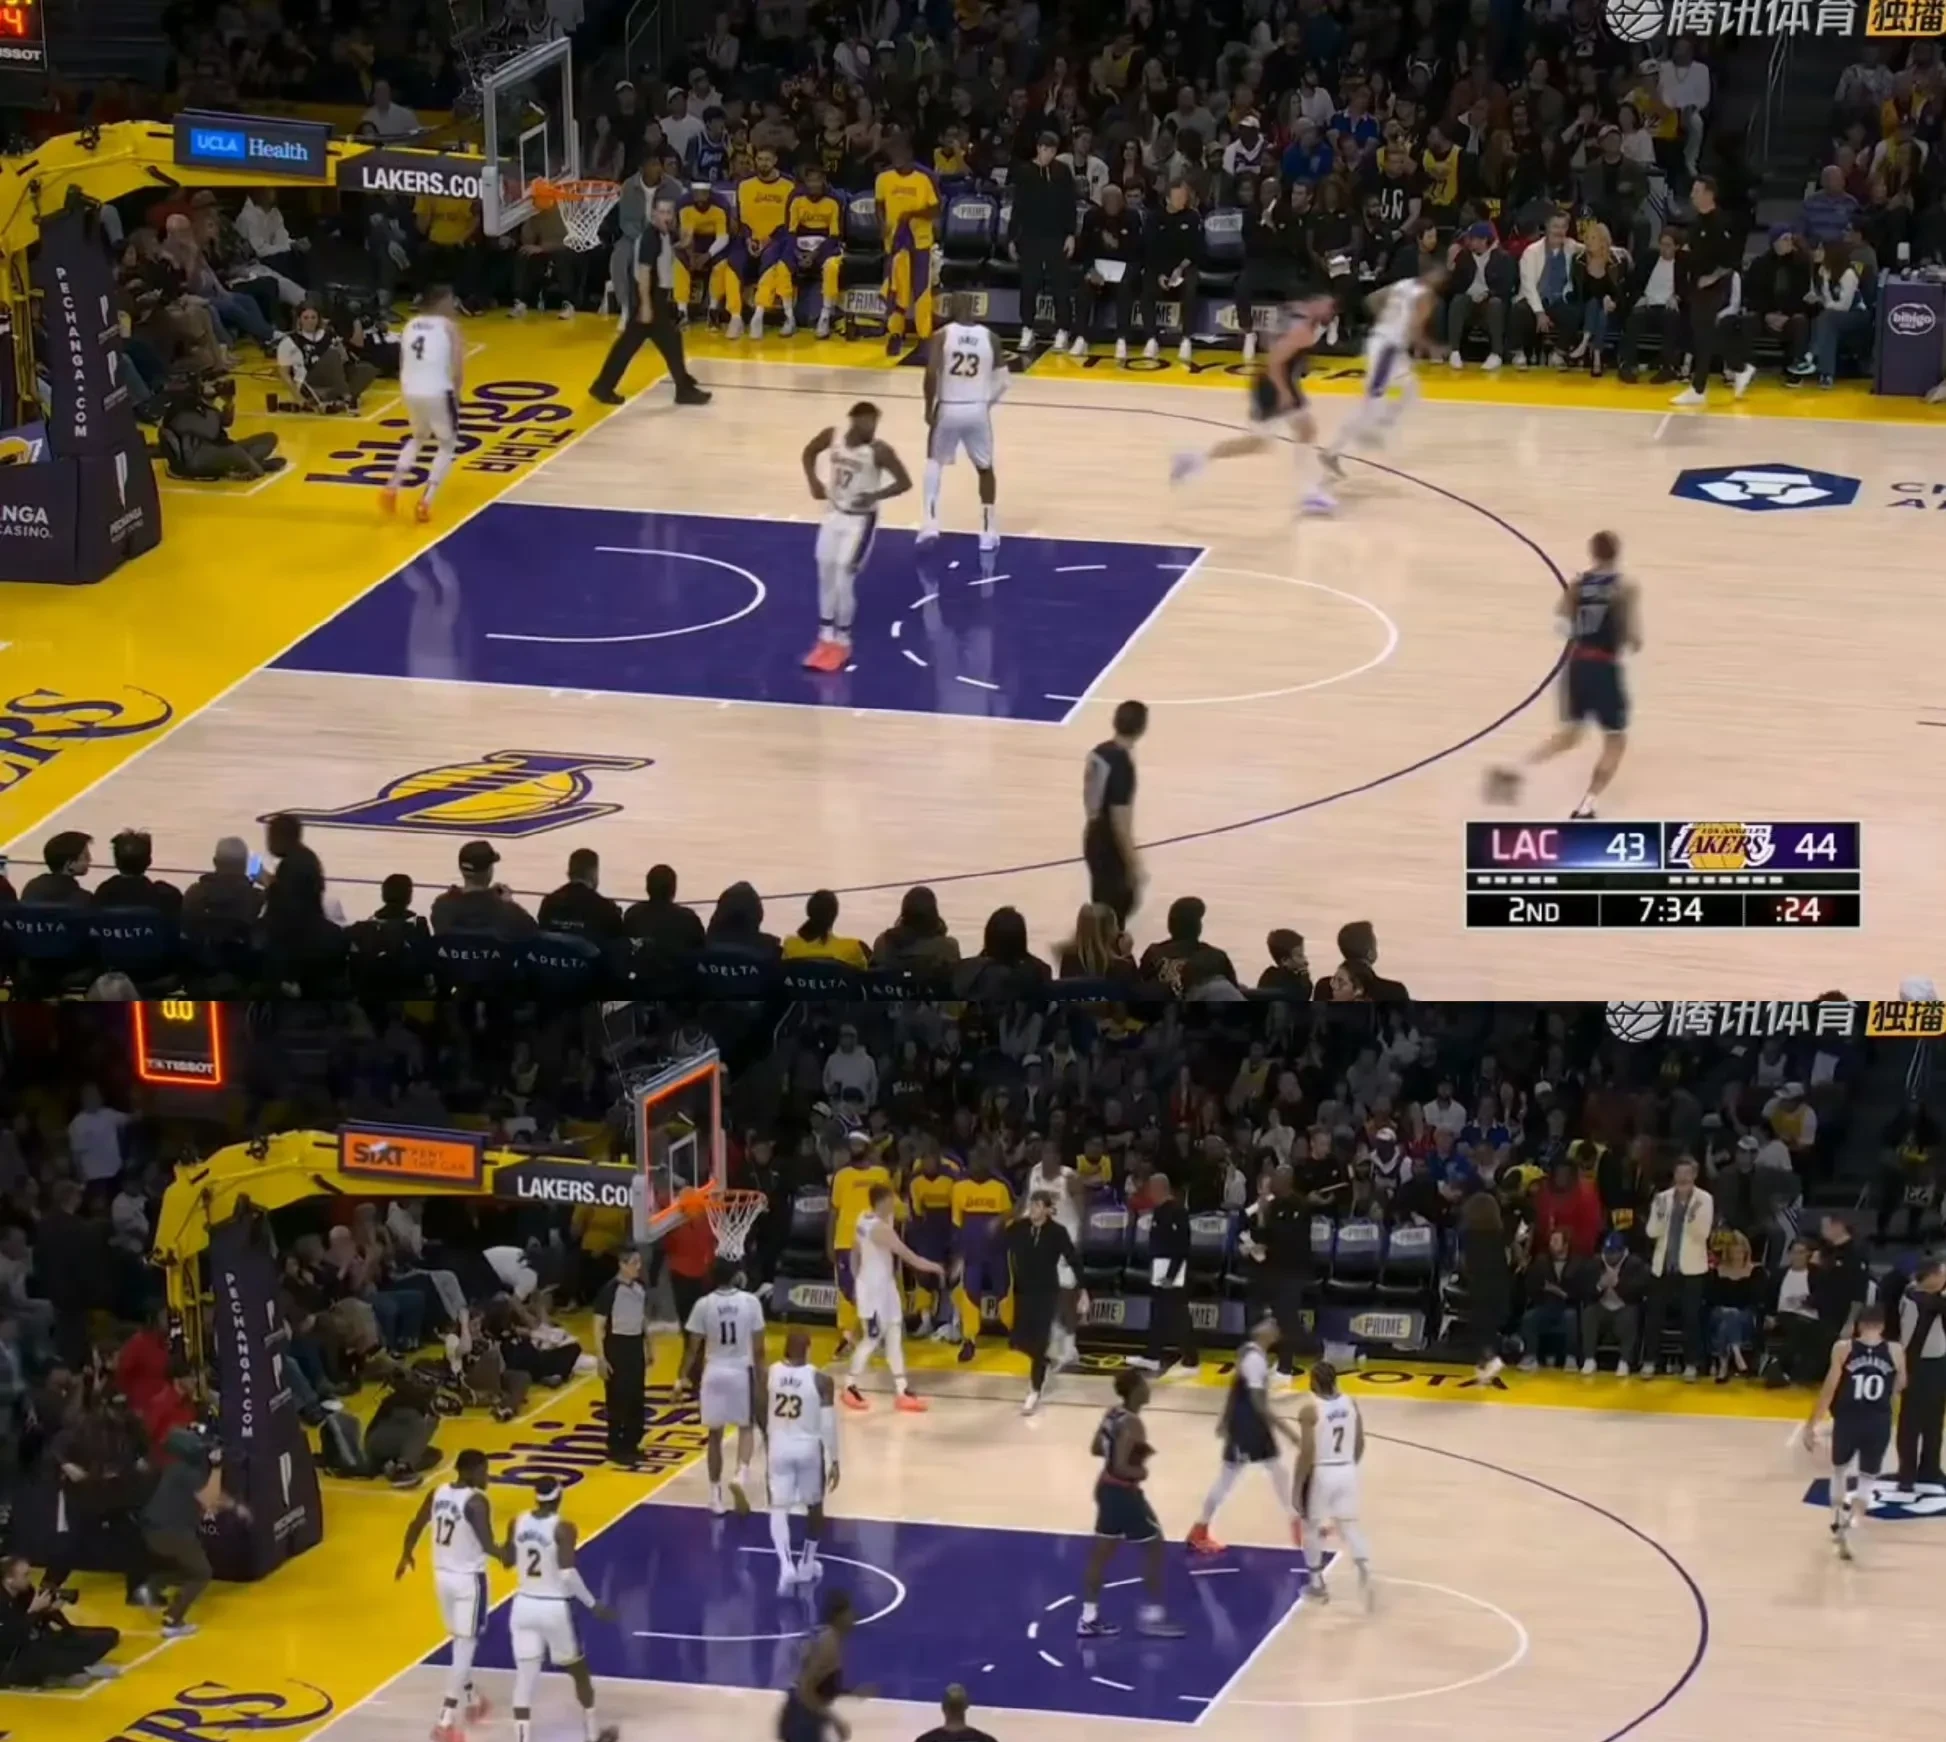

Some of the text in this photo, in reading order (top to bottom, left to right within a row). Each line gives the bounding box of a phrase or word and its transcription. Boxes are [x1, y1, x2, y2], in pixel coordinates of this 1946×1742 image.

[0, 47, 42, 61] SSOT
[197, 135, 309, 162] UCLA Health
[410, 335, 426, 361] 4
[950, 351, 981, 378] 23
[0, 525, 51, 539] ASINO
[16, 920, 66, 933] DELTA
[103, 927, 154, 939] DELTA
[450, 949, 501, 960] DELTA
[710, 963, 760, 976] DELTA
[797, 976, 848, 990] DELTA
[720, 1320, 737, 1346] 11
[1363, 1316, 1406, 1337] PRIME
[1851, 1373, 1885, 1402] 10
[774, 1392, 803, 1419] 23
[1332, 1425, 1345, 1454] 7
[435, 1514, 455, 1547] 17
[527, 1547, 542, 1578] 2
